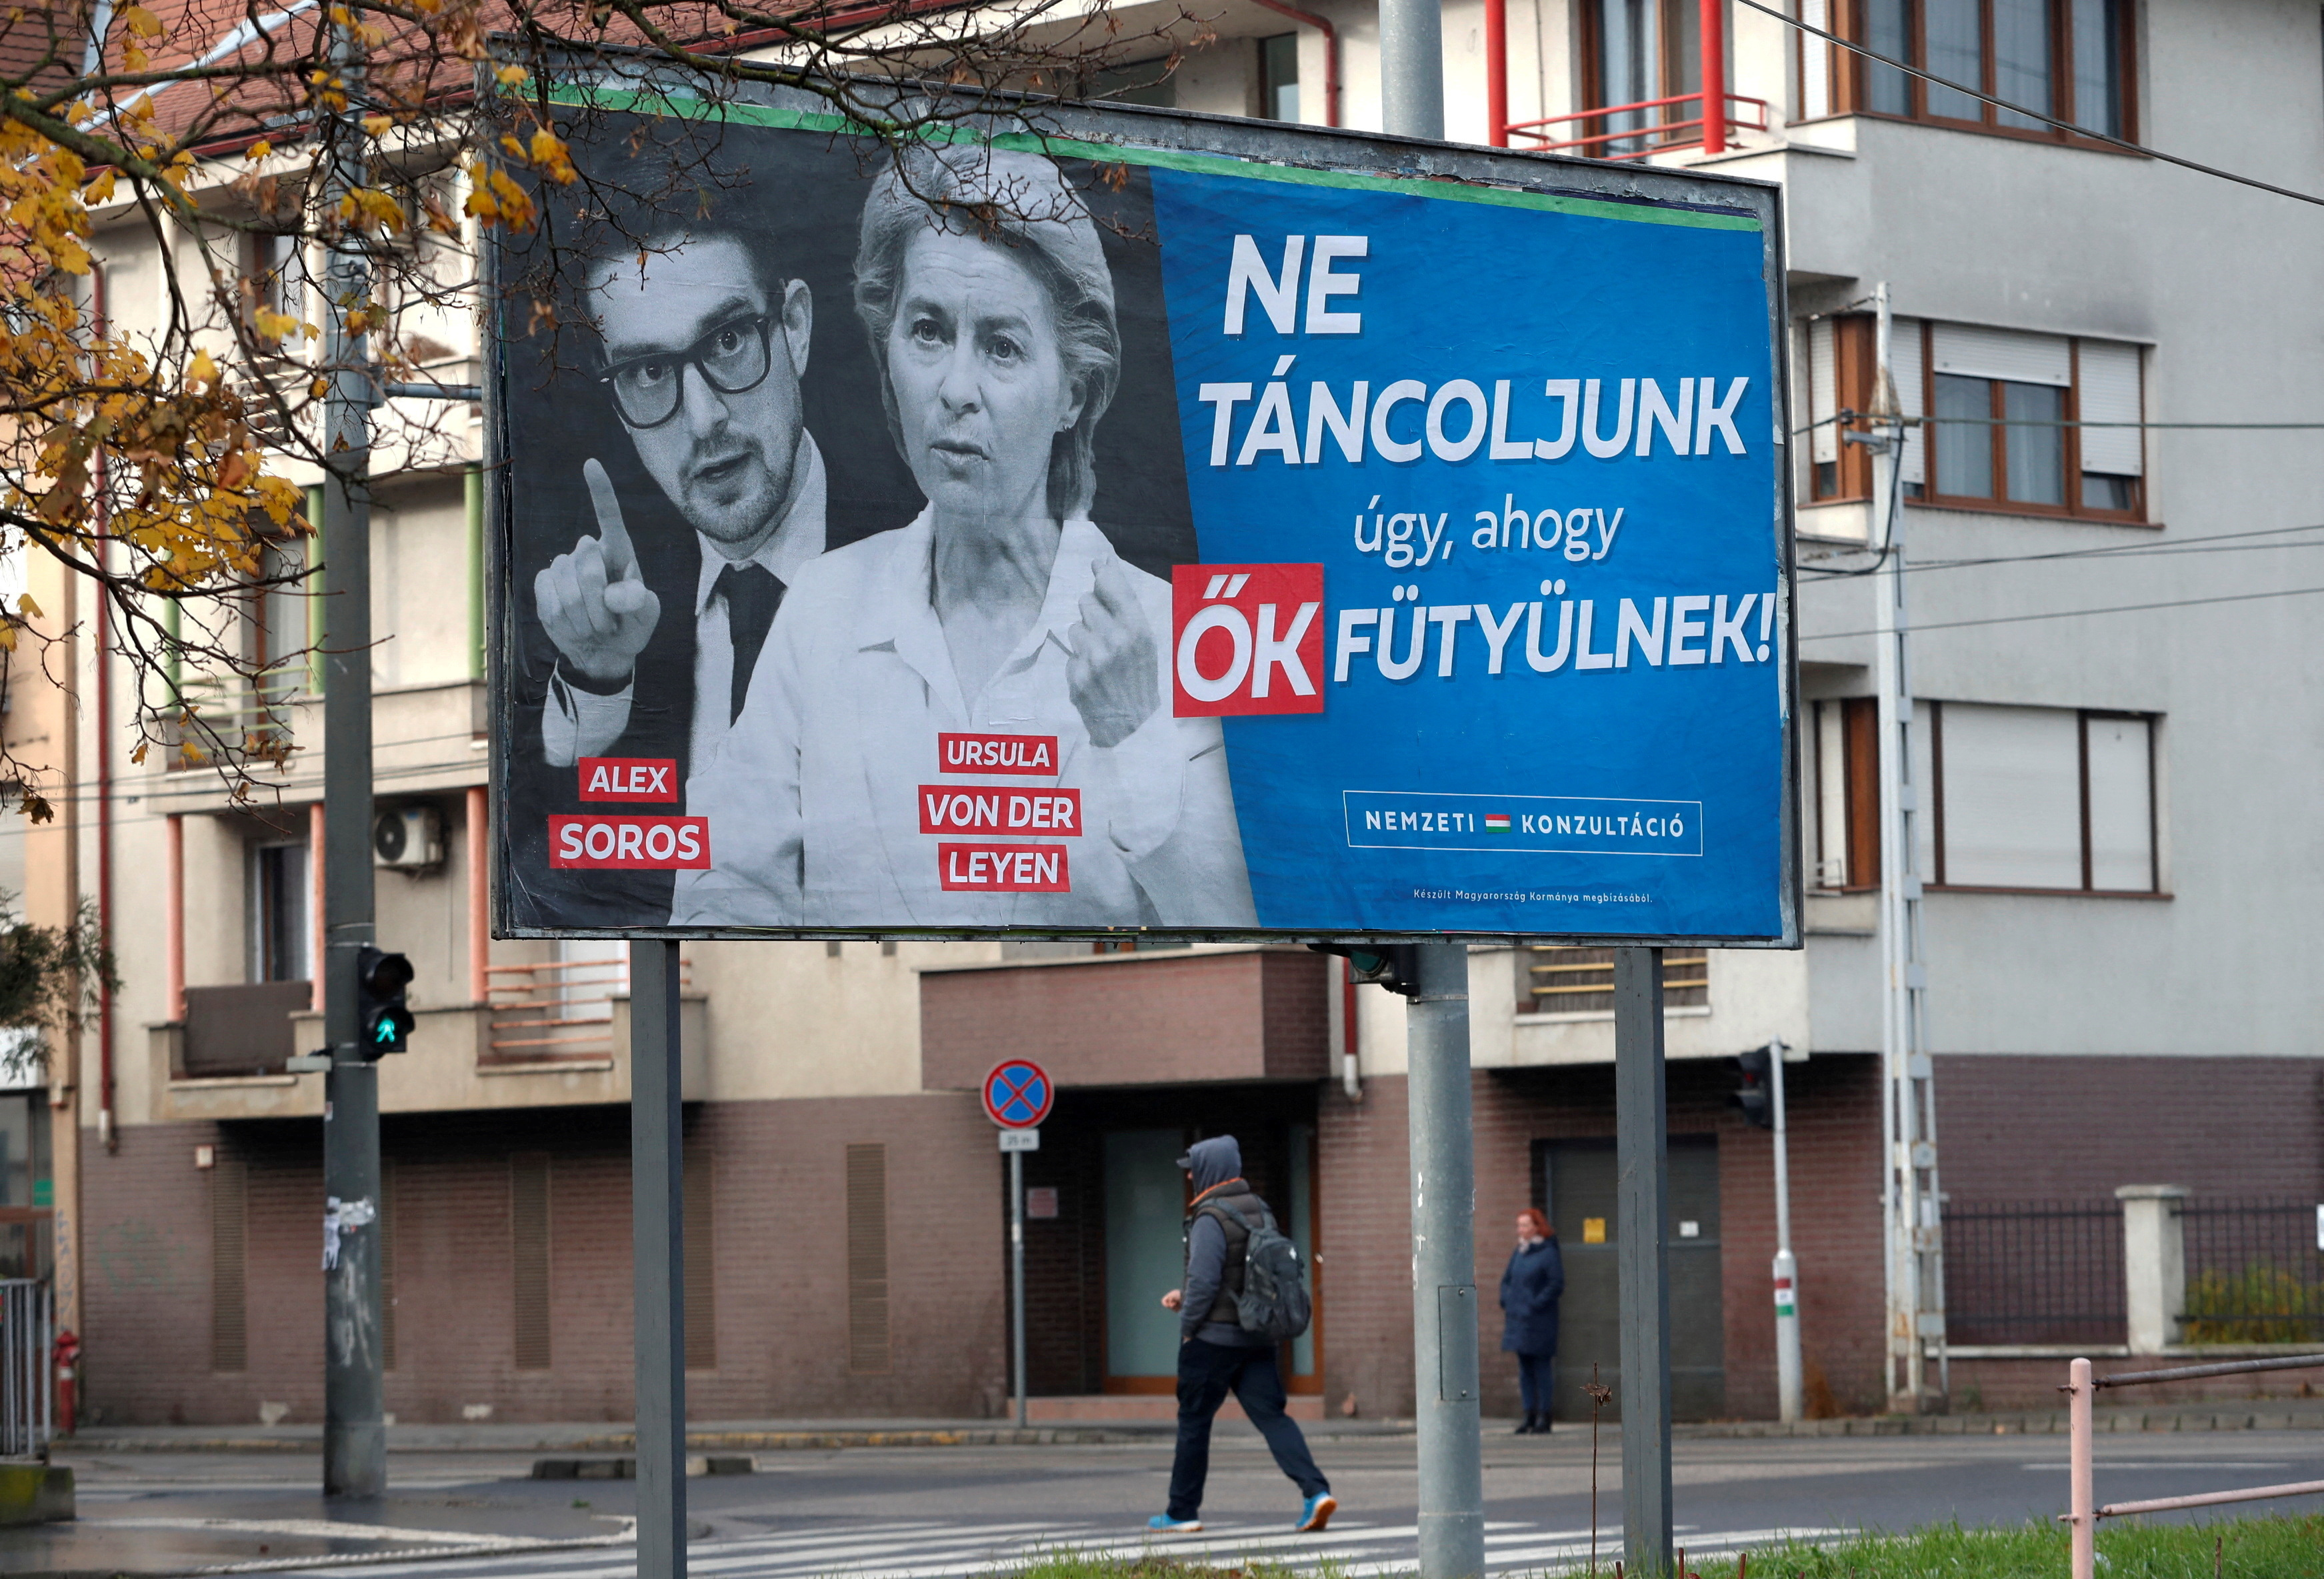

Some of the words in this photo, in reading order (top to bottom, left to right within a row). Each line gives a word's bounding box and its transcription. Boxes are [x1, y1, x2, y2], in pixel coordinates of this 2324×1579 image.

[1224, 235, 1367, 334] NE
[1199, 355, 1749, 465] TÁNCOLJUNK
[1355, 495, 1453, 567] úgy,
[1472, 493, 1624, 561] ahogy
[1177, 573, 1320, 701] ŐK
[1334, 579, 1776, 681] FÜTYÜLNEK!
[947, 740, 1050, 767] URSULA
[587, 765, 669, 794] ALEX
[926, 794, 999, 827] VON
[1008, 796, 1074, 828] DER
[1365, 810, 1474, 832] NEMZETI
[1521, 812, 1683, 838] KONZULTÁCIÓ
[559, 823, 700, 860] SOROS
[949, 852, 1059, 884] LEYEN
[1413, 889, 1451, 899] Készült
[1455, 890, 1526, 903] Magyarország
[1529, 892, 1579, 904] Kormánya
[1583, 892, 1653, 904] megbízásából.
